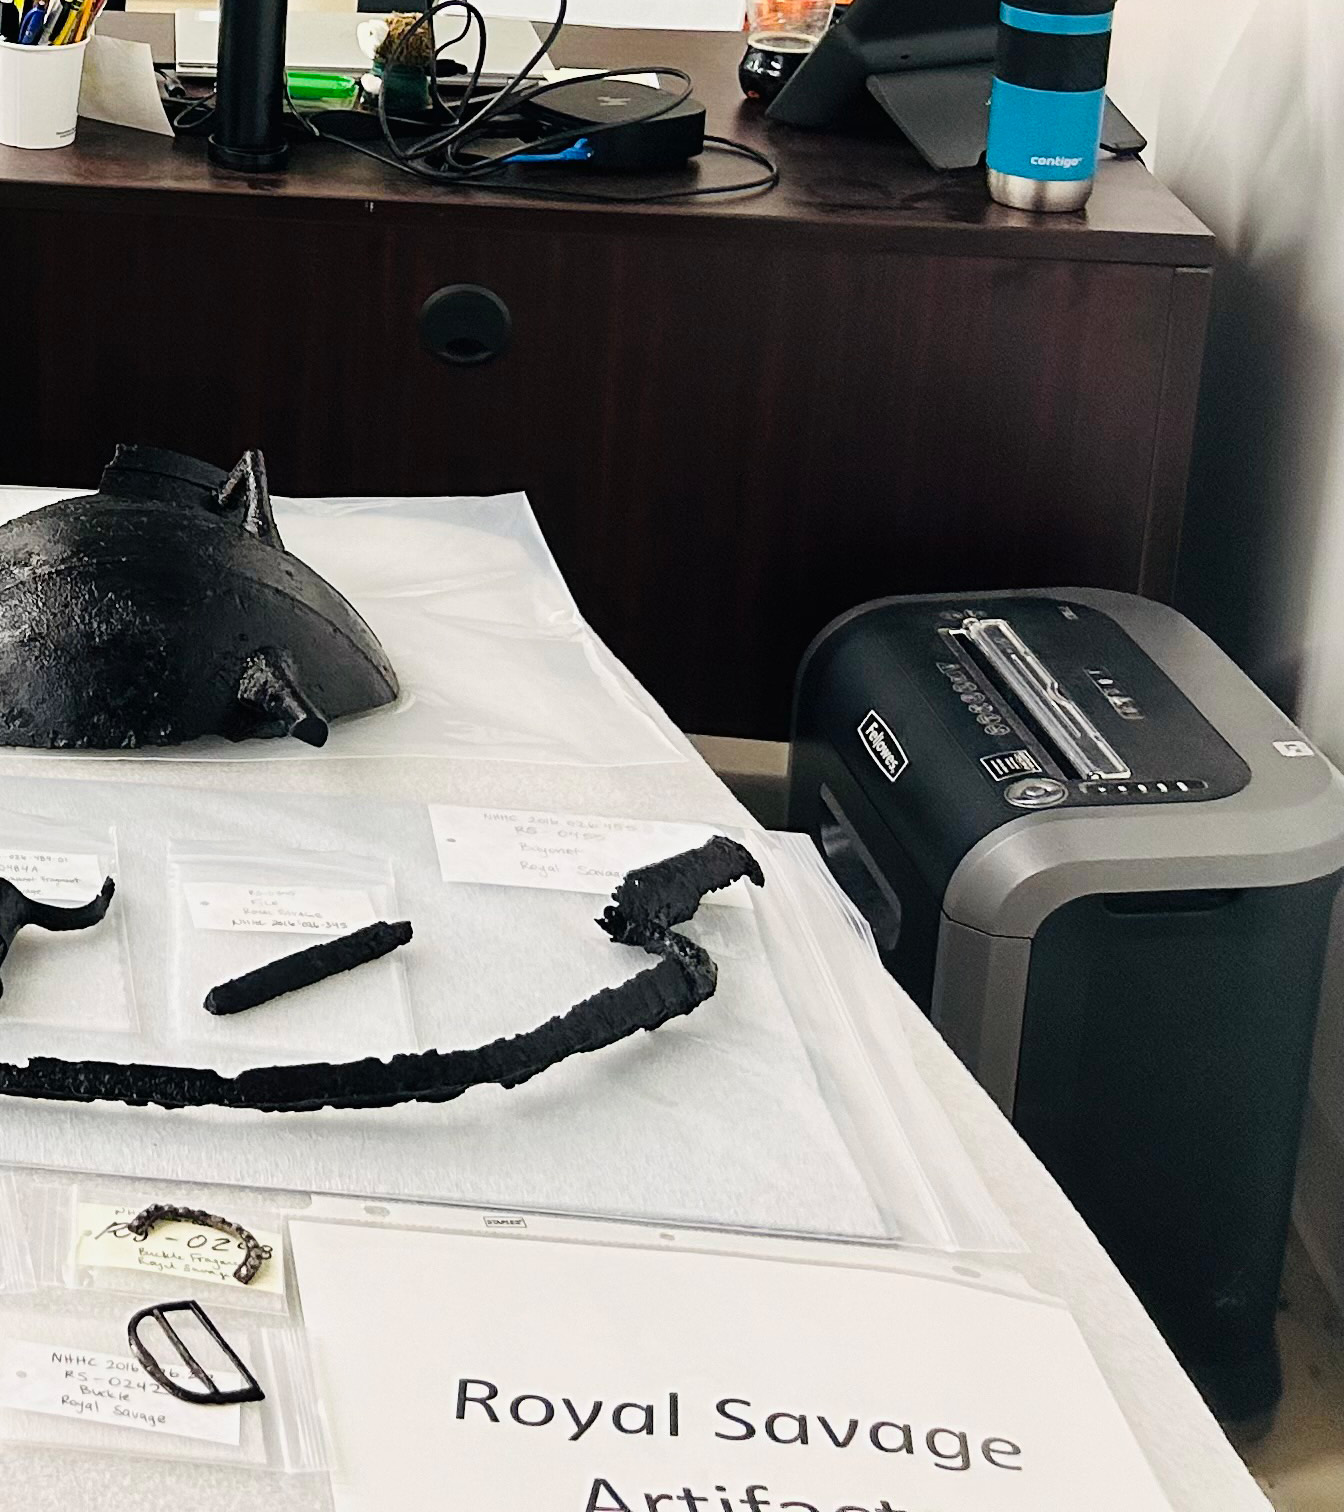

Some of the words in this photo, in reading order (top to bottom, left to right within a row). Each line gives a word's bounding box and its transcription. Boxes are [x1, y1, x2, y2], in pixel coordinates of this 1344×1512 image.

[1030, 155, 1081, 169] contigo
[519, 860, 560, 878] Royal
[51, 1351, 98, 1367] NHHC
[79, 1384, 131, 1402] Buckle
[61, 1394, 100, 1414] Royal
[112, 1404, 167, 1427] Savage
[454, 1377, 680, 1442] Royal
[713, 1397, 1025, 1472] Savage
